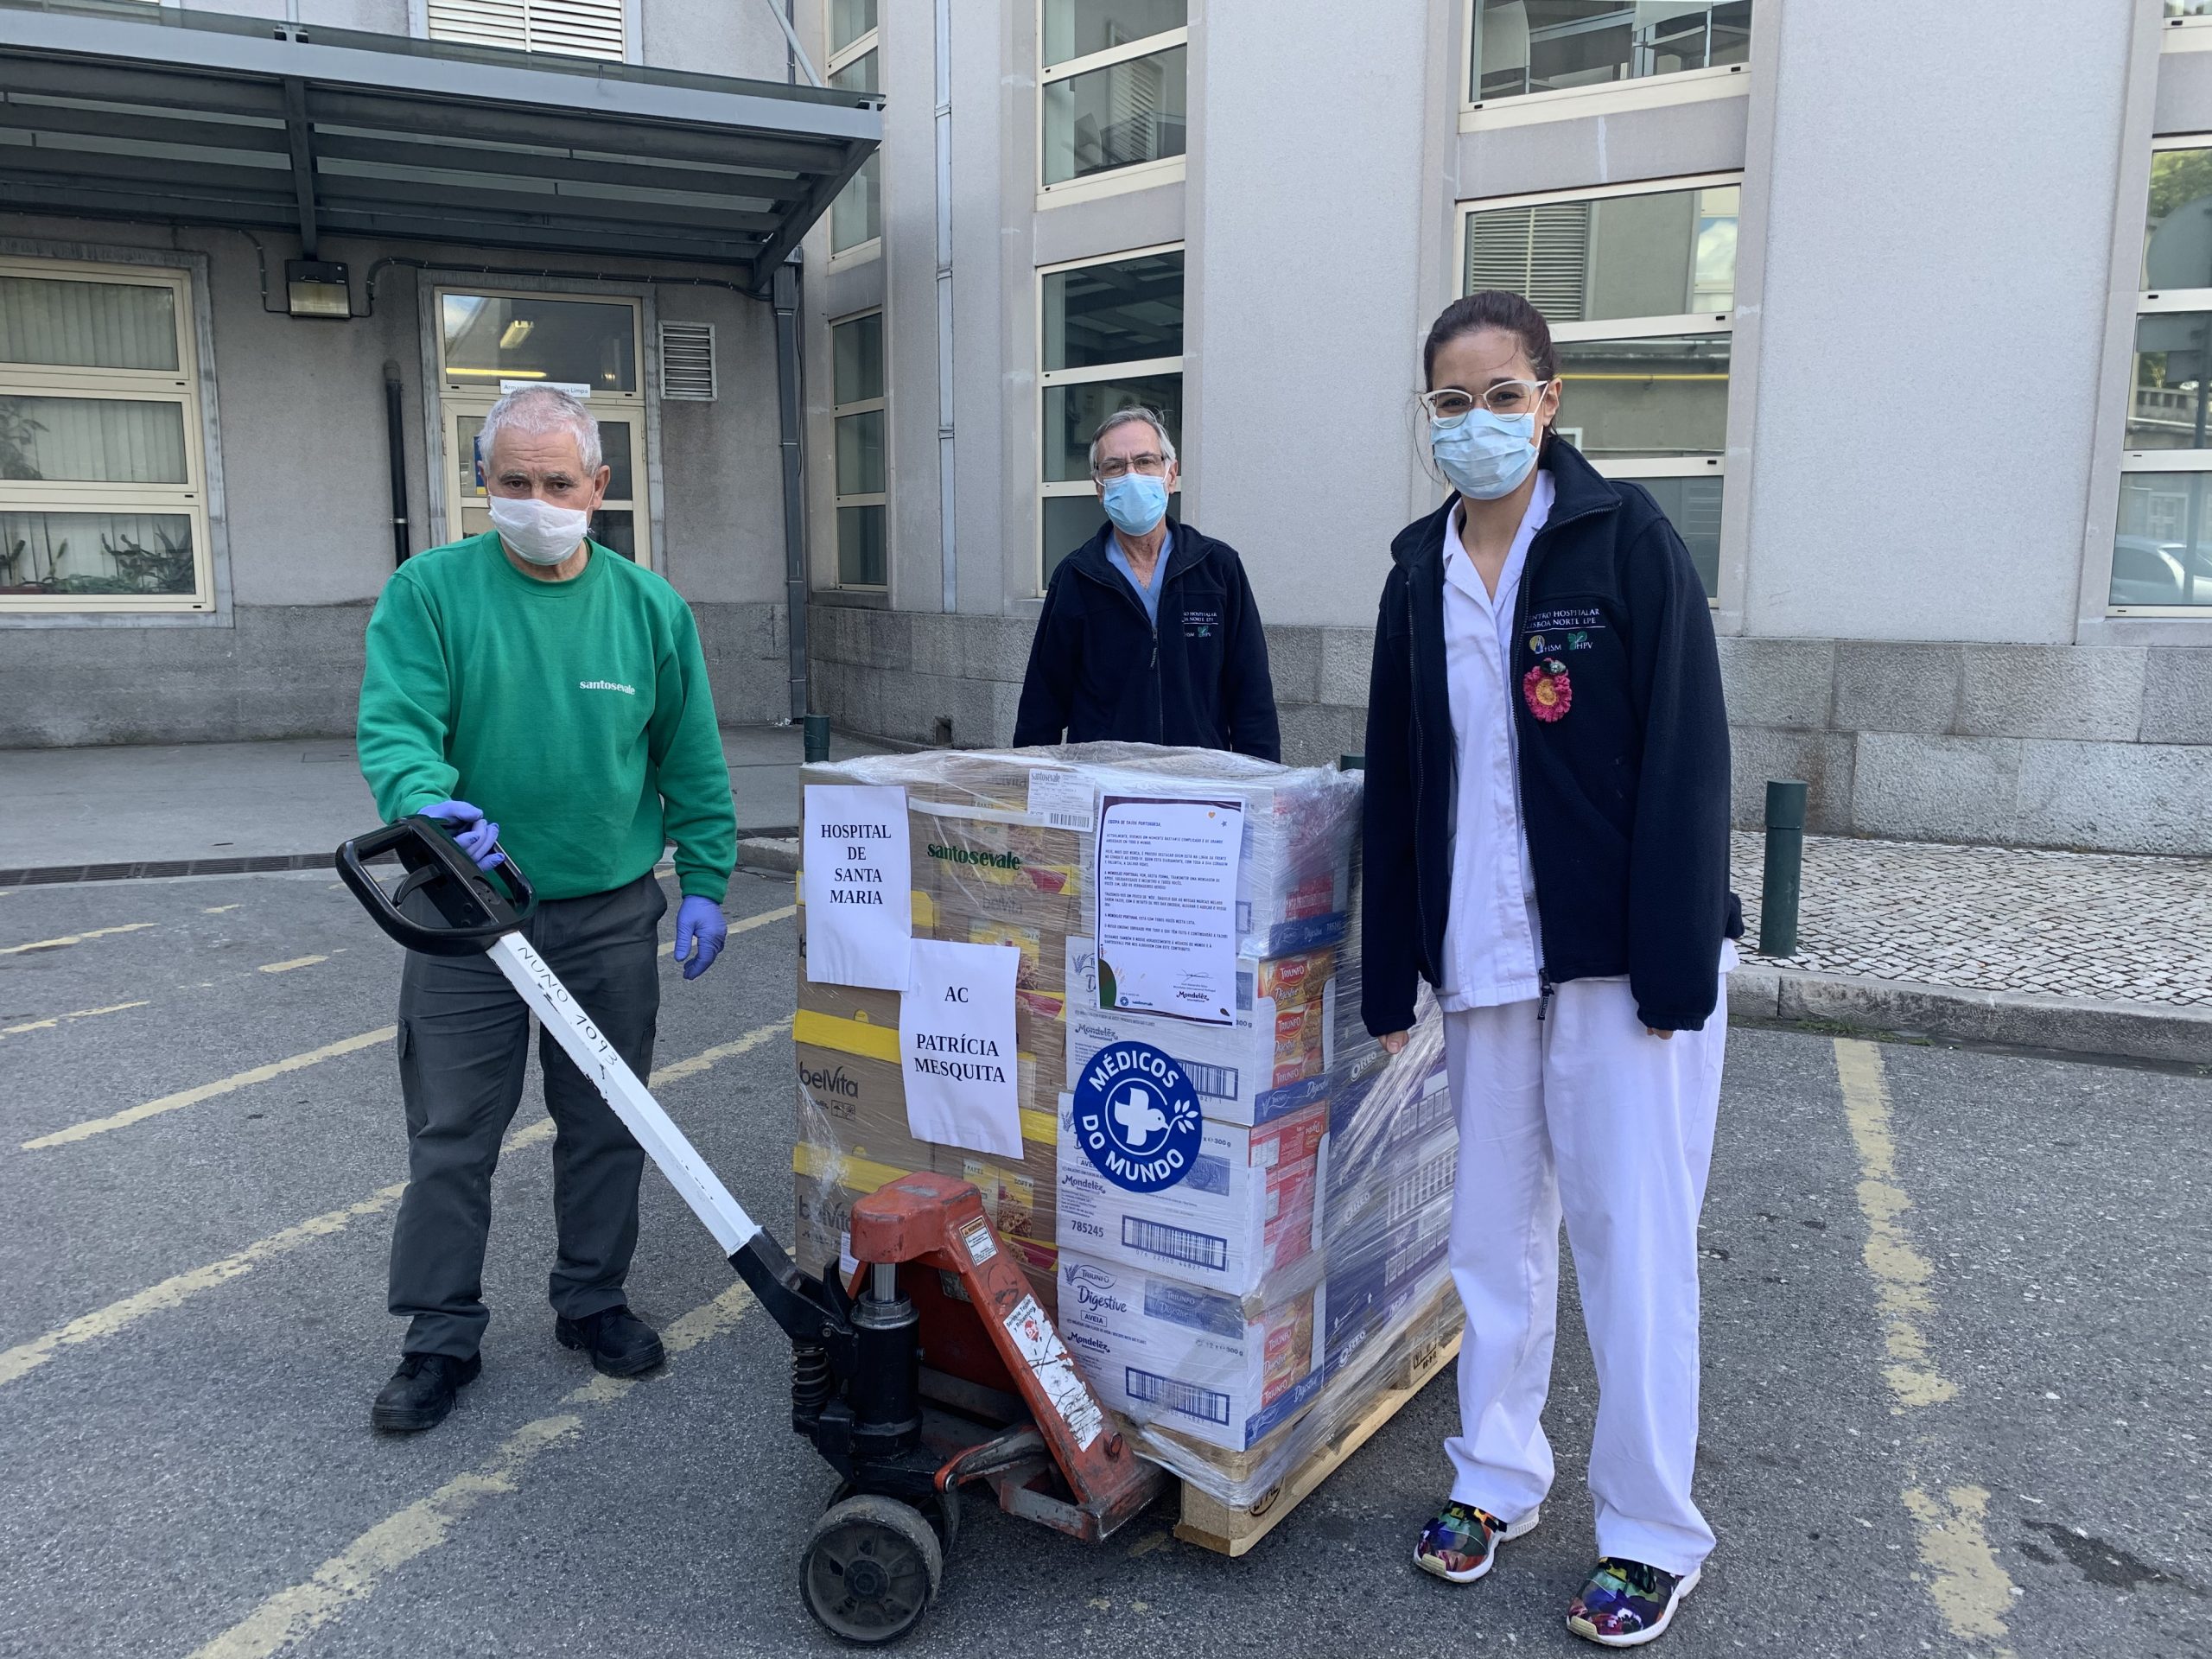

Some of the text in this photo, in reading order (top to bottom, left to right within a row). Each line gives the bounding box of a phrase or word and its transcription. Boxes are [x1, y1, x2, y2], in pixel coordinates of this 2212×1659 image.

[1528, 608, 1601, 621] ENTRO HOSPITALAR
[1576, 641, 1594, 650] HPV
[580, 680, 635, 695] santosevale
[1031, 772, 1062, 783] santosevale
[821, 824, 891, 839] HOSPITAL
[847, 846, 866, 861] DE
[927, 843, 1020, 871] santosevale
[835, 868, 882, 883] SANTA
[830, 889, 883, 905] MARIA
[518, 947, 568, 1002] NUNO
[1280, 965, 1305, 980] TRIUNFO
[945, 986, 969, 1003] AC
[1278, 1017, 1301, 1033] TRIUNFO
[916, 1033, 1000, 1057] PATRÍCIA
[913, 1058, 1006, 1083] MESQUITA
[1089, 1050, 1179, 1092] MÉDICOS
[1351, 1052, 1376, 1082] OREO
[799, 1061, 859, 1099] belVita
[1276, 1068, 1300, 1085] TRIUNFO
[1082, 1114, 1185, 1183] DO MUNDO
[1071, 1221, 1104, 1237] 785245
[1081, 1268, 1110, 1284] TRIUNFO
[1077, 1285, 1127, 1313] Digestive
[1166, 1291, 1197, 1305] TRIUNFO
[1084, 1313, 1104, 1325] AVEIA
[1268, 1328, 1293, 1351] TRIUNFO
[1338, 1330, 1366, 1367] OREO
[1265, 1379, 1288, 1404] TRIUNFO
